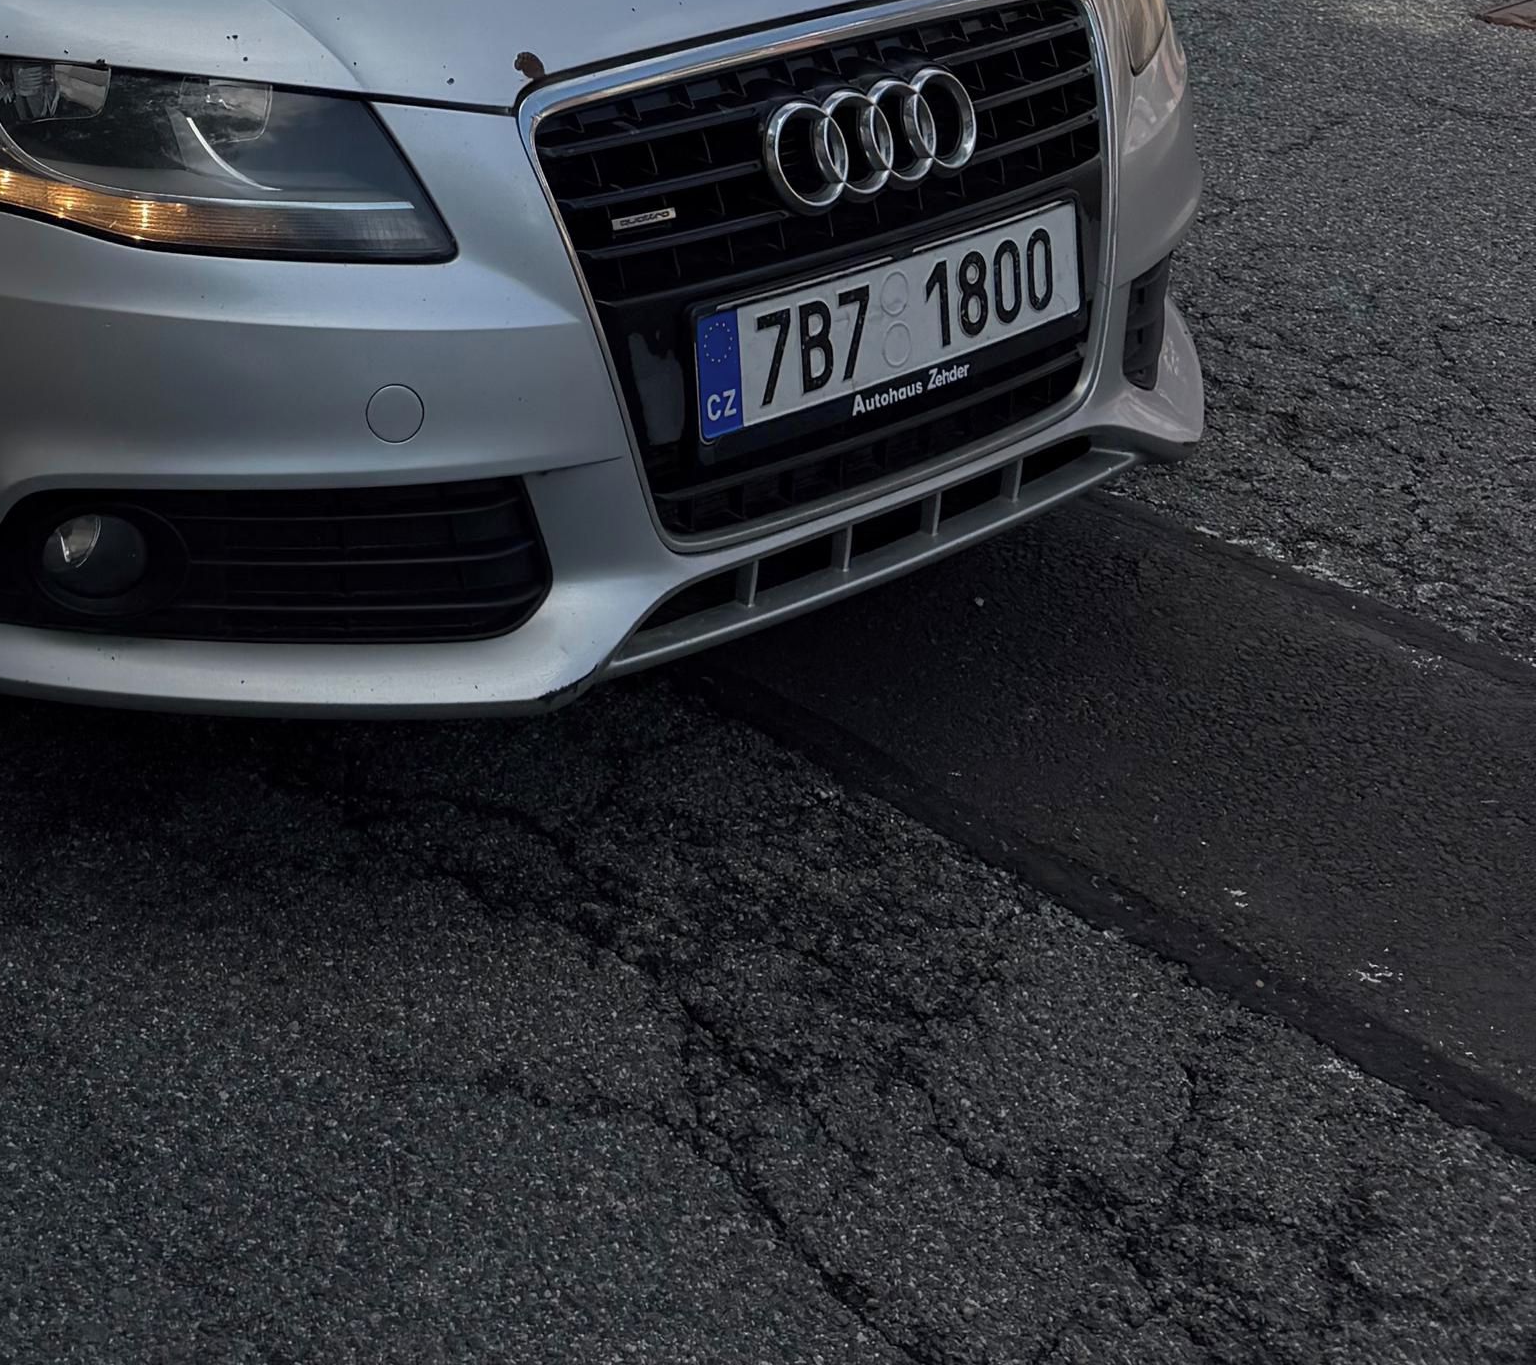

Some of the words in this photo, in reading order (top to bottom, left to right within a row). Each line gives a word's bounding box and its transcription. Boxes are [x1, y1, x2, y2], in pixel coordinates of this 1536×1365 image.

[756, 285, 870, 406] 7B7
[925, 228, 1052, 348] 1800
[707, 389, 736, 421] CZ
[852, 381, 923, 416] Autohaus
[927, 364, 970, 390] Zehder
